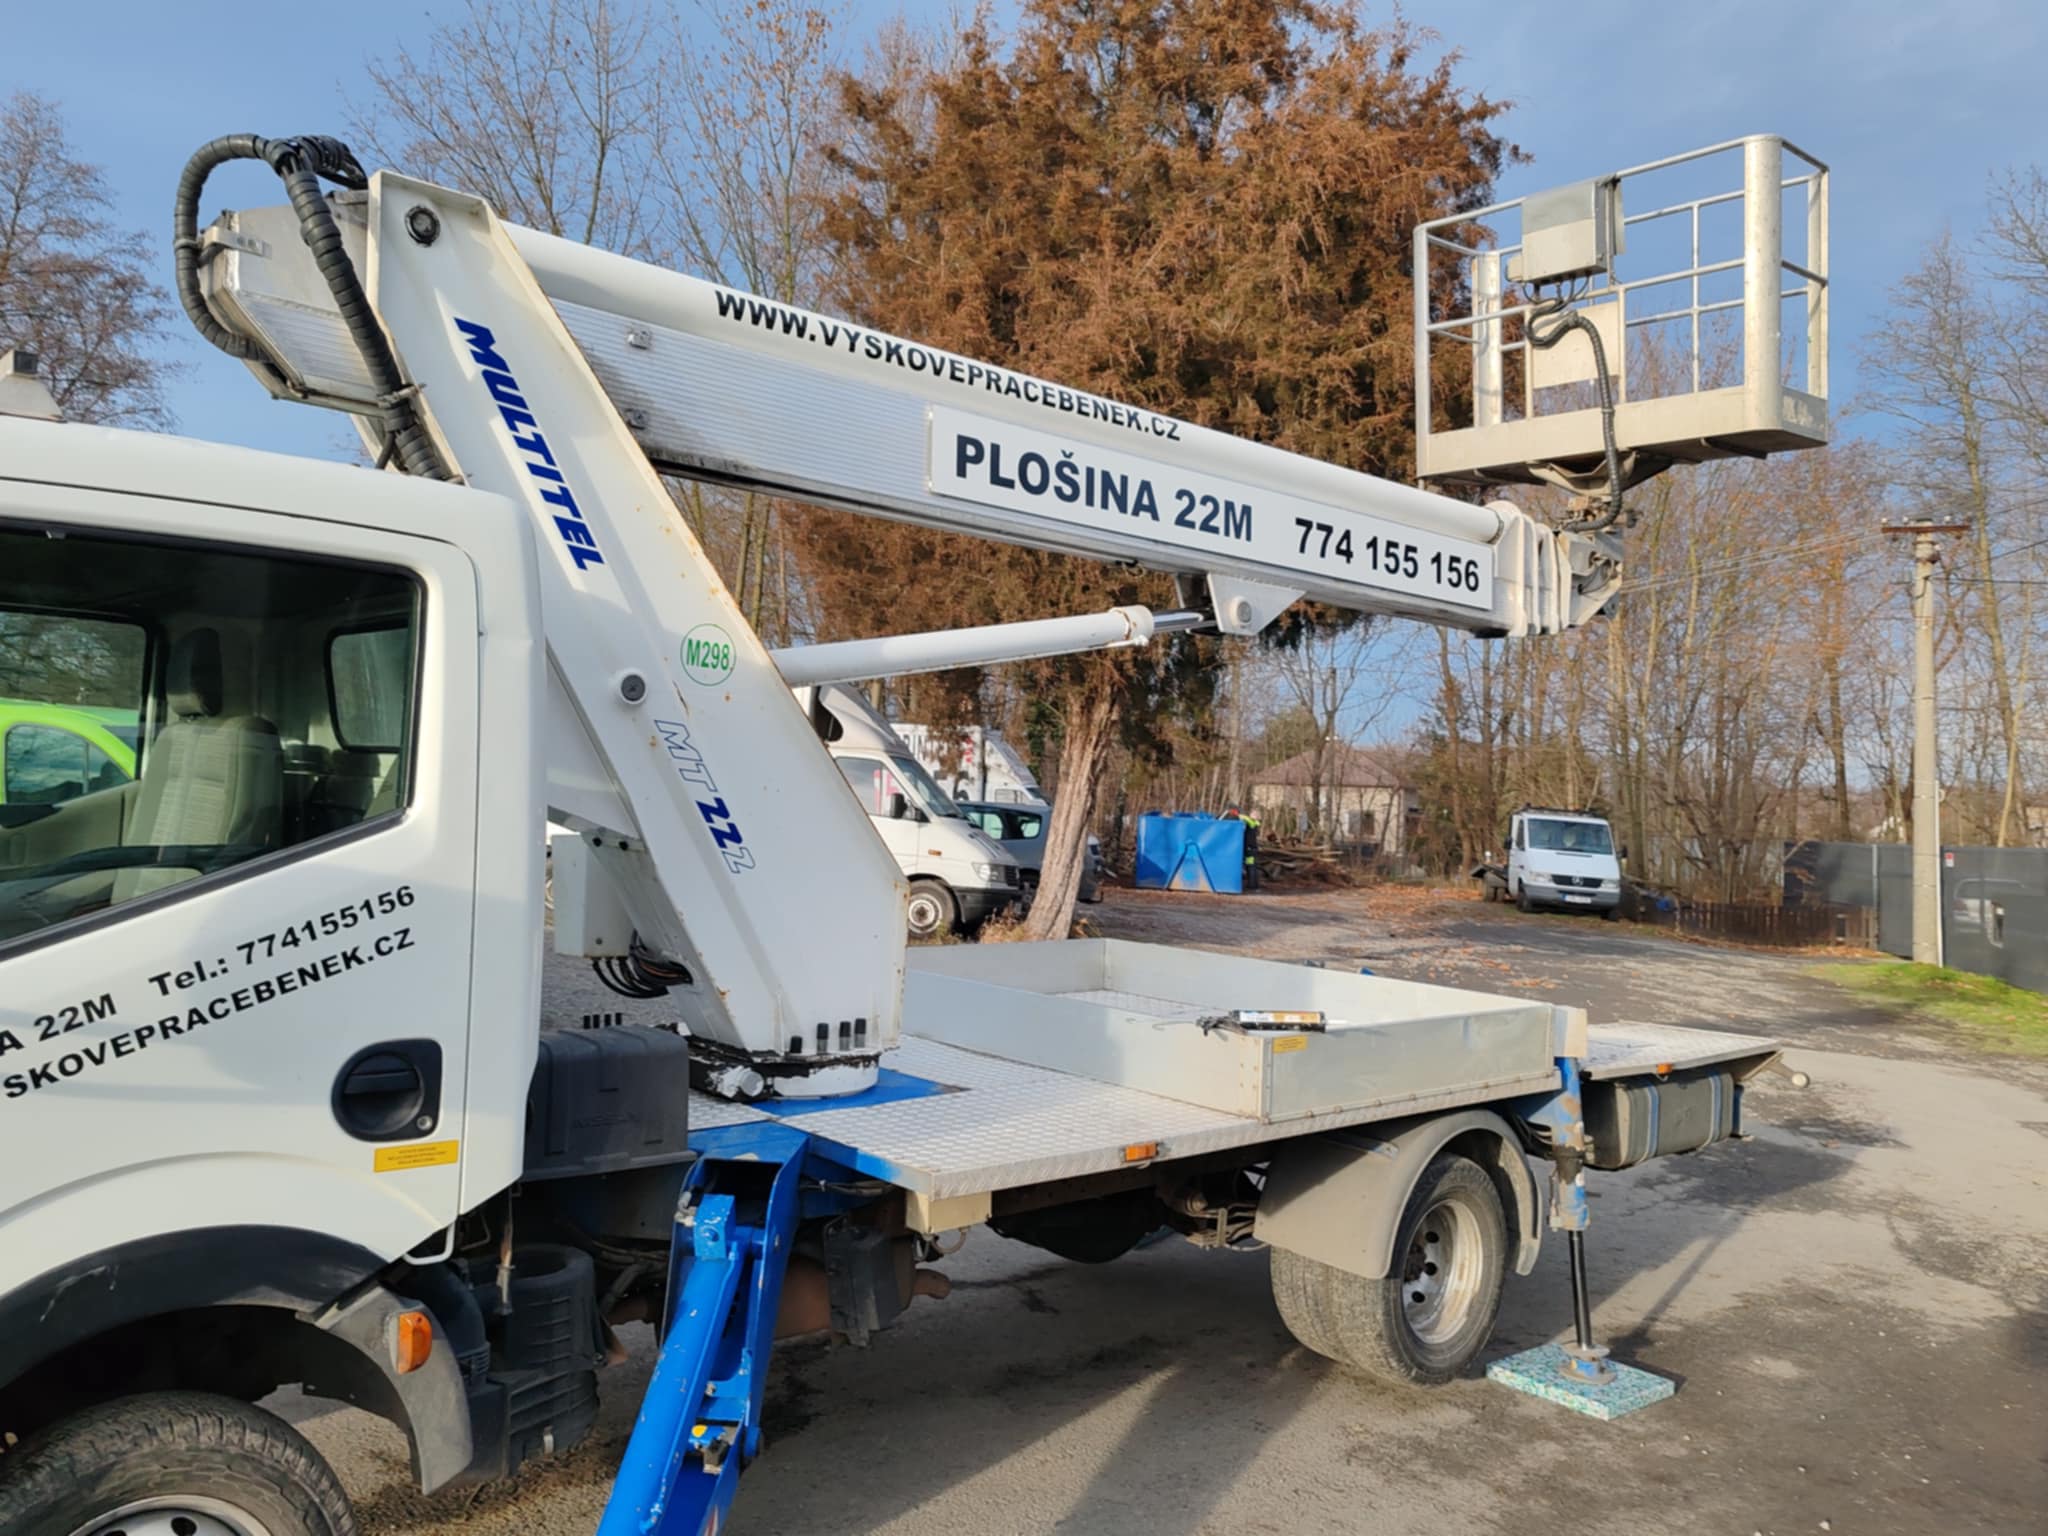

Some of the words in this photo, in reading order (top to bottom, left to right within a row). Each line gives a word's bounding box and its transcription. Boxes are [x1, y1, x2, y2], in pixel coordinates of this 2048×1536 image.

[454, 317, 604, 570] MULTITEL
[715, 290, 1180, 441] WWW.VYSKOVEPRACEBENEK.CZ
[956, 434, 1160, 522] PLOŠINA
[1174, 489, 1252, 542] 22M
[1295, 517, 1354, 564] 774
[1366, 535, 1419, 579] 155
[1430, 551, 1479, 592] 156
[686, 638, 730, 671] M298
[3, 927, 415, 1099] SKOVEPRACEBENEK.CZ
[33, 993, 117, 1042] 22M
[148, 958, 229, 996] Tel.:
[236, 885, 415, 965] 774155156
